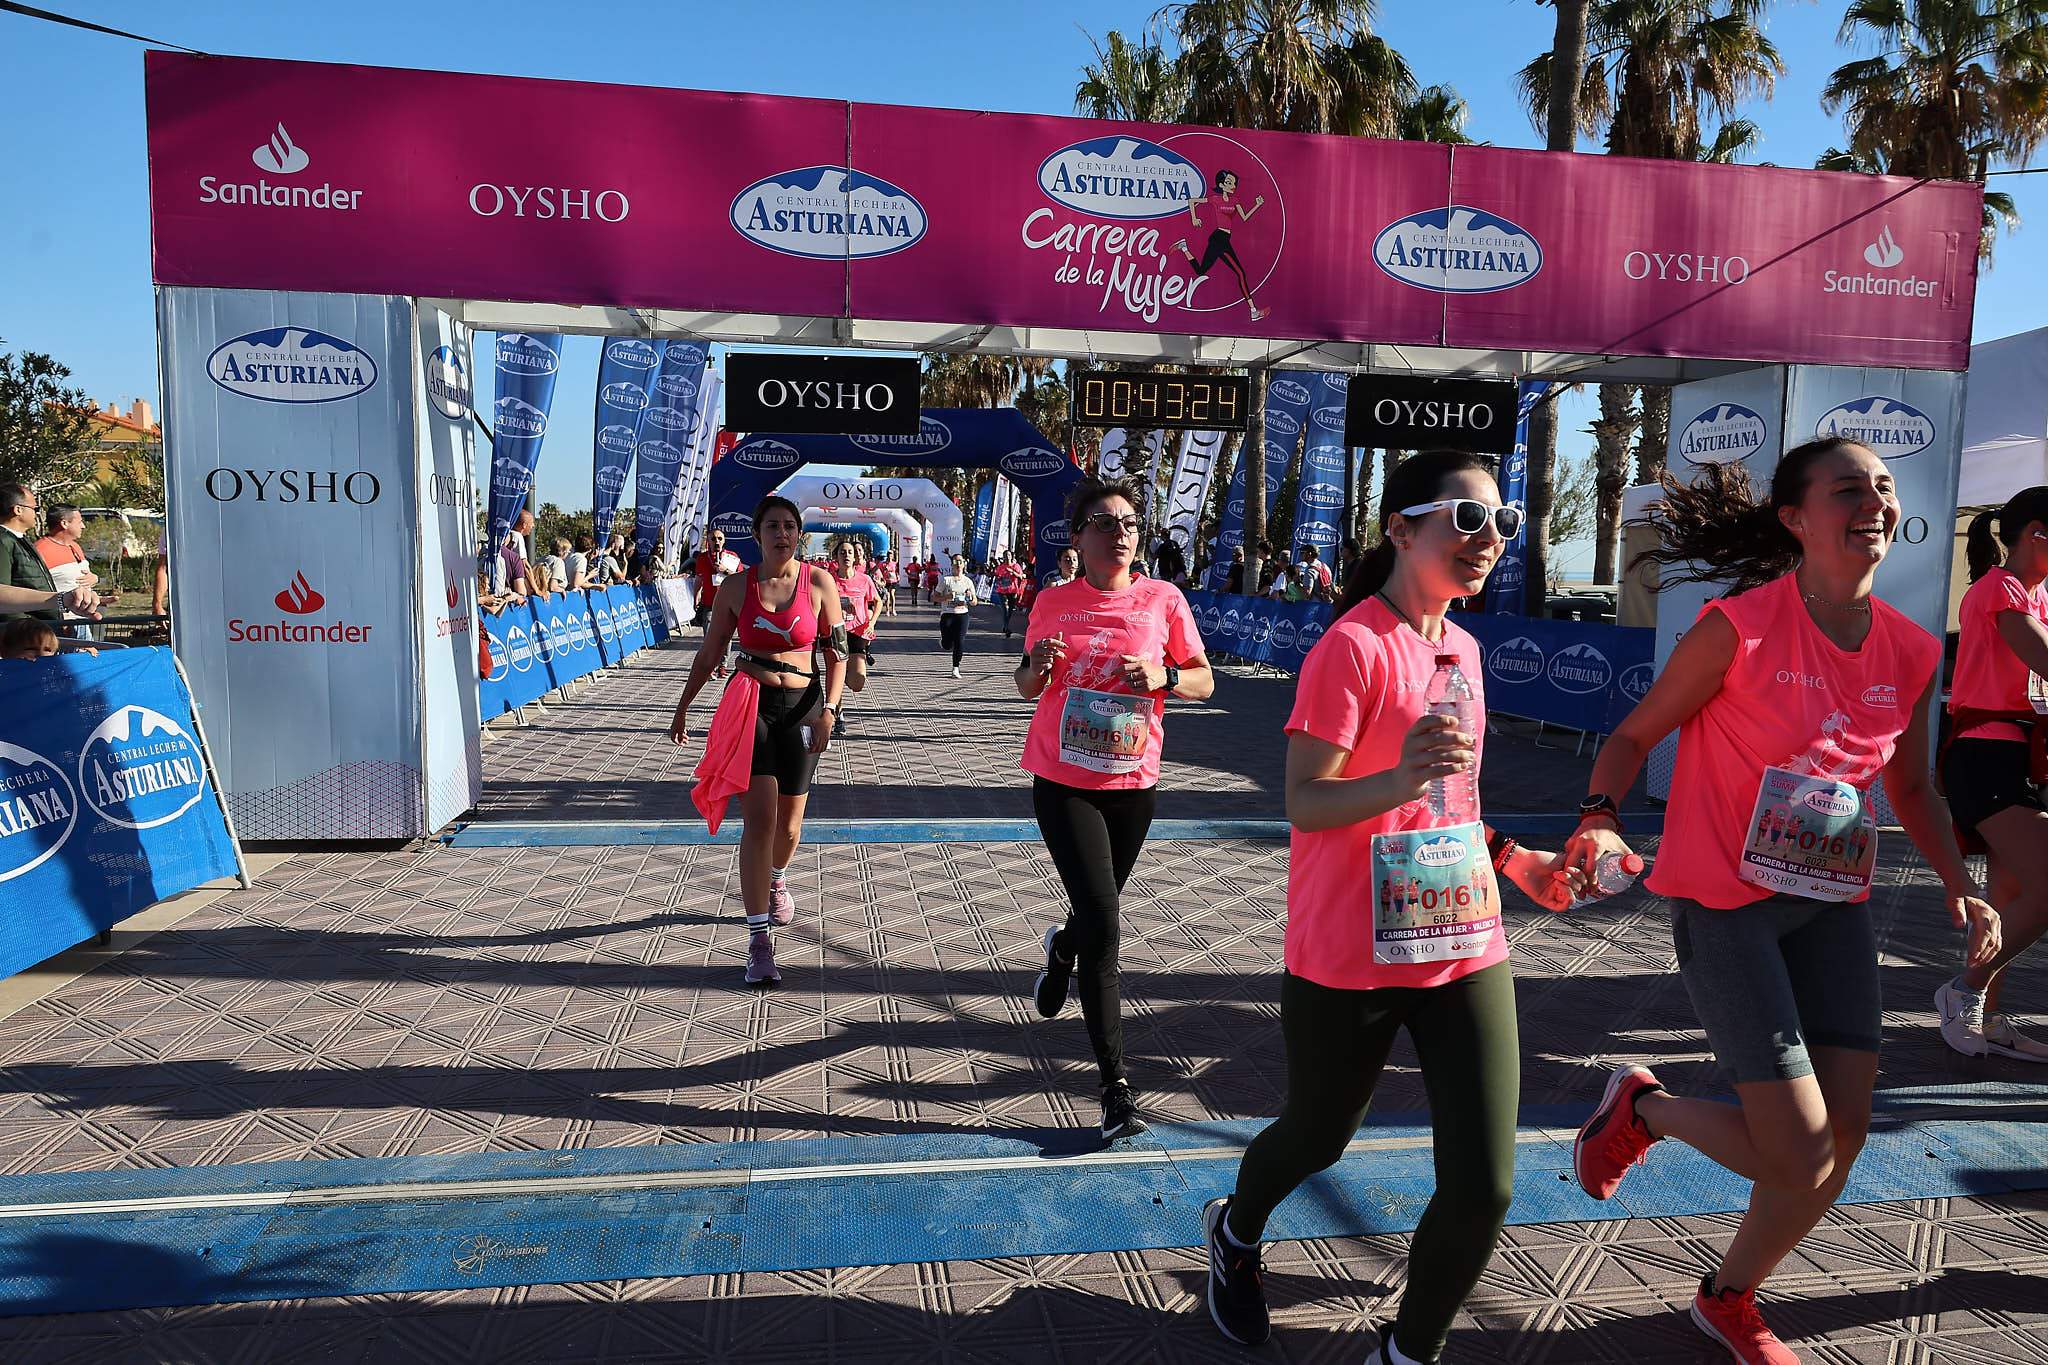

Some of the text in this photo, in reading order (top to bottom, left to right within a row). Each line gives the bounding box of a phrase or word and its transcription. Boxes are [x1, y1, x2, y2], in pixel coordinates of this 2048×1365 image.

[1077, 161, 1189, 177] CENTRAL LECHERA
[1051, 161, 1192, 201] ASTURIANA
[199, 175, 363, 211] Santander
[469, 183, 630, 223] OYSHO
[776, 195, 907, 212] CENTRAL LECHERA
[746, 196, 913, 239] ASTURIANA
[1022, 208, 1160, 258] Carrera
[1413, 234, 1525, 248] CENTRAL LECHERA
[1386, 235, 1530, 273] ASTURIANA
[1624, 251, 1750, 285] OYSHO
[1054, 255, 1209, 323] de la Mujer
[1824, 269, 1938, 299] Santander
[246, 351, 359, 364] CENTRAL LECHERA
[220, 353, 366, 387] ASTURIANA
[758, 378, 894, 412] OYSHO
[1086, 380, 1236, 420] 00:43:24
[1374, 398, 1494, 431] OYSHO
[1842, 417, 1923, 427] CENTRAL LECHERA
[1684, 430, 1759, 454] ASTURIANA
[738, 449, 795, 464] ASTURIANA
[1005, 458, 1061, 470] ASTURIANA
[205, 468, 381, 505] OYSHO
[429, 472, 471, 508] OYSHO
[822, 482, 904, 501] OYSHO
[924, 501, 949, 509] OYSHO
[1060, 613, 1095, 623] OYSHO
[229, 619, 372, 643] Santander
[1491, 652, 1540, 674] ASTURIANA
[1550, 659, 1604, 685] ASTURIANA
[1776, 670, 1827, 690] OYSHO
[1089, 727, 1121, 742] 016
[107, 745, 147, 764] CENTRAL
[0, 769, 50, 791] ECHERA
[97, 755, 200, 807] ASTURIANA
[1808, 794, 1853, 813] ASTURIANA
[1800, 831, 1845, 855] 016
[1418, 848, 1466, 862] ASTURIANA
[1805, 856, 1827, 868] 6023
[1750, 854, 1786, 870] CARRERA
[1788, 863, 1797, 872] DE
[1799, 866, 1808, 874] LA
[1809, 867, 1831, 879] MUJER
[1836, 872, 1864, 885] VALENCIA
[1755, 869, 1798, 887] OYSHO
[1421, 885, 1471, 910] 016
[1383, 930, 1418, 940] CARRERA
[1419, 928, 1429, 937] DE
[1431, 927, 1441, 936] LA
[1442, 924, 1467, 935] MUJER
[1472, 919, 1496, 932] VALENCIA
[1433, 913, 1458, 925] 6022
[1390, 943, 1435, 956] OYSHO
